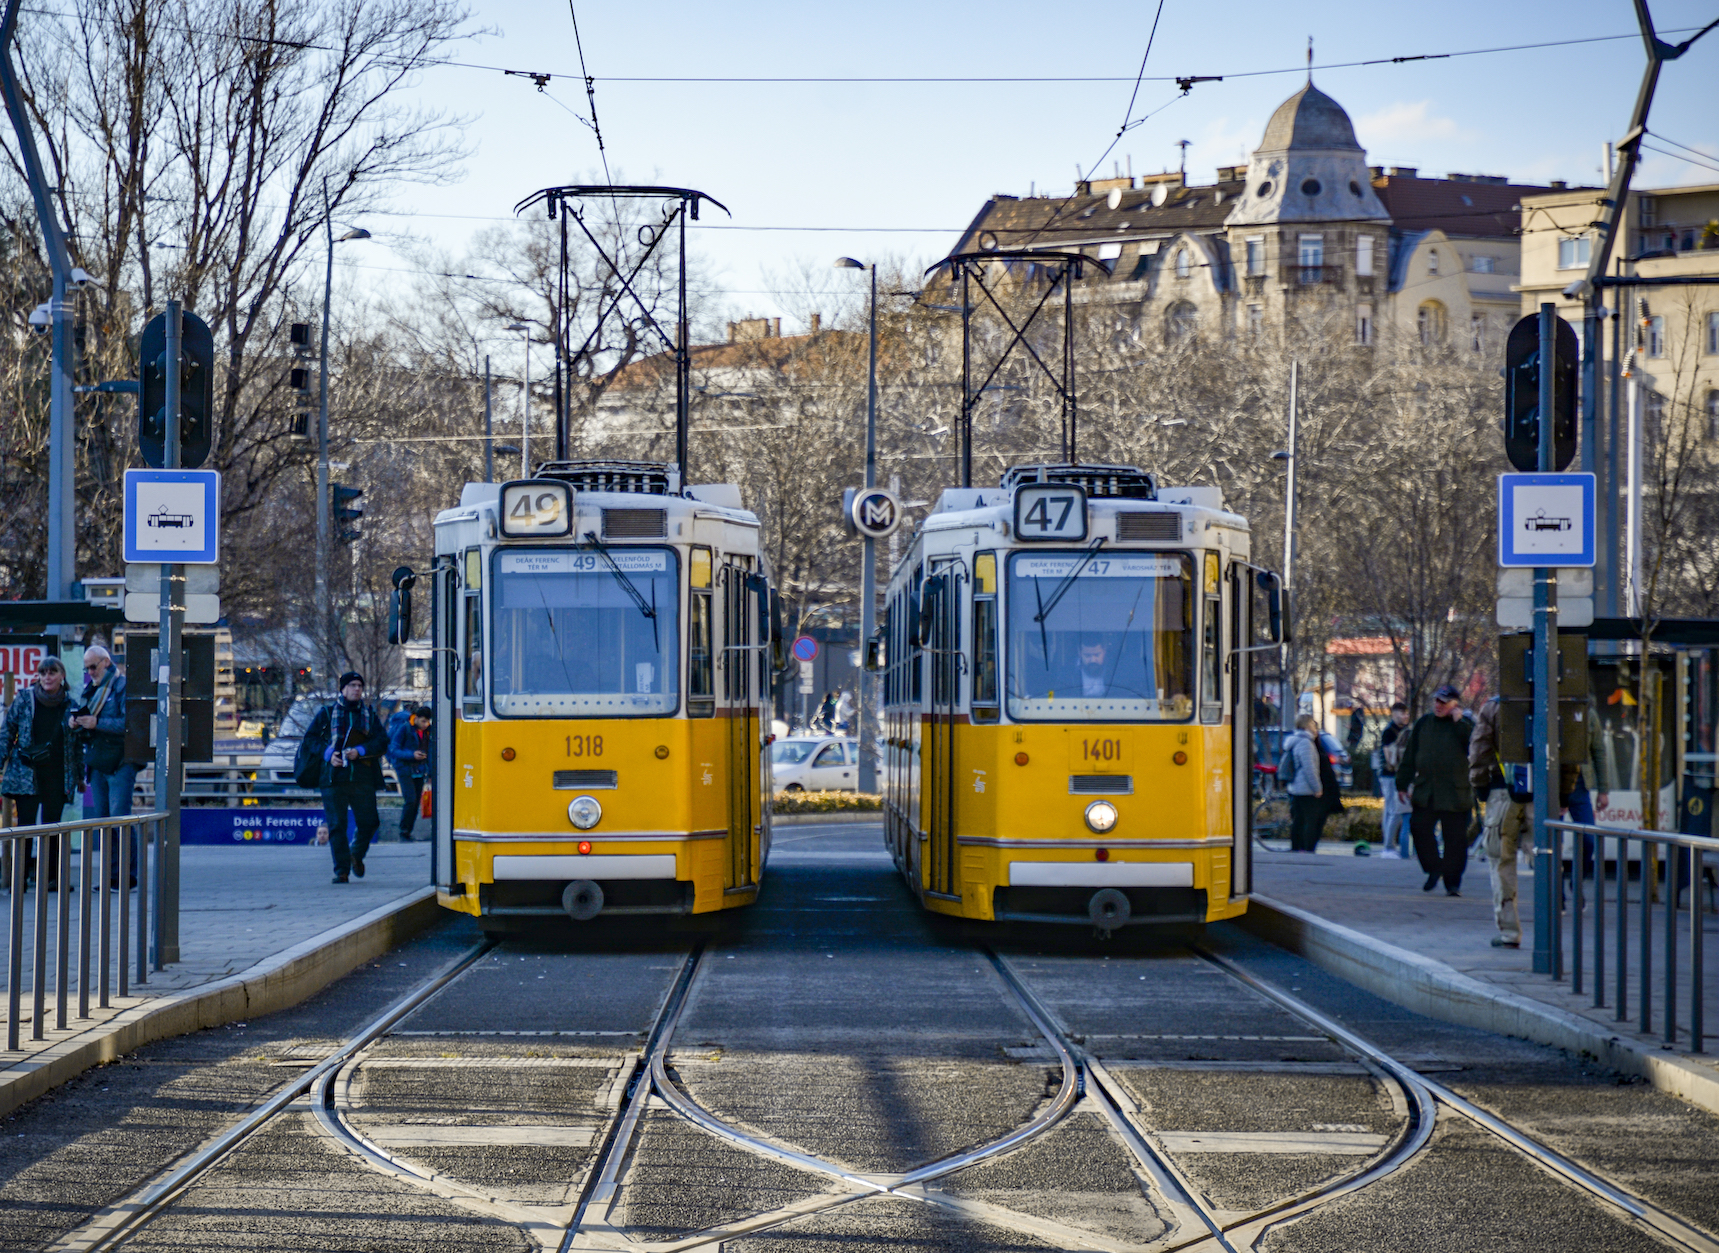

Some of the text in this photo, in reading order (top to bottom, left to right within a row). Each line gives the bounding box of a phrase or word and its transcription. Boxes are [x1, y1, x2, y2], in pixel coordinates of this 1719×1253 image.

[510, 493, 560, 526] 49
[865, 499, 891, 526] M
[1024, 496, 1075, 532] 47
[515, 556, 534, 564] DEÁK
[573, 555, 596, 571] 49
[601, 562, 654, 570] VASTÁLLOMÁS
[1087, 561, 1111, 575] 47
[565, 735, 604, 757] 1318
[1082, 739, 1121, 761] 1401
[233, 815, 324, 827] Deák Ferenc tér
